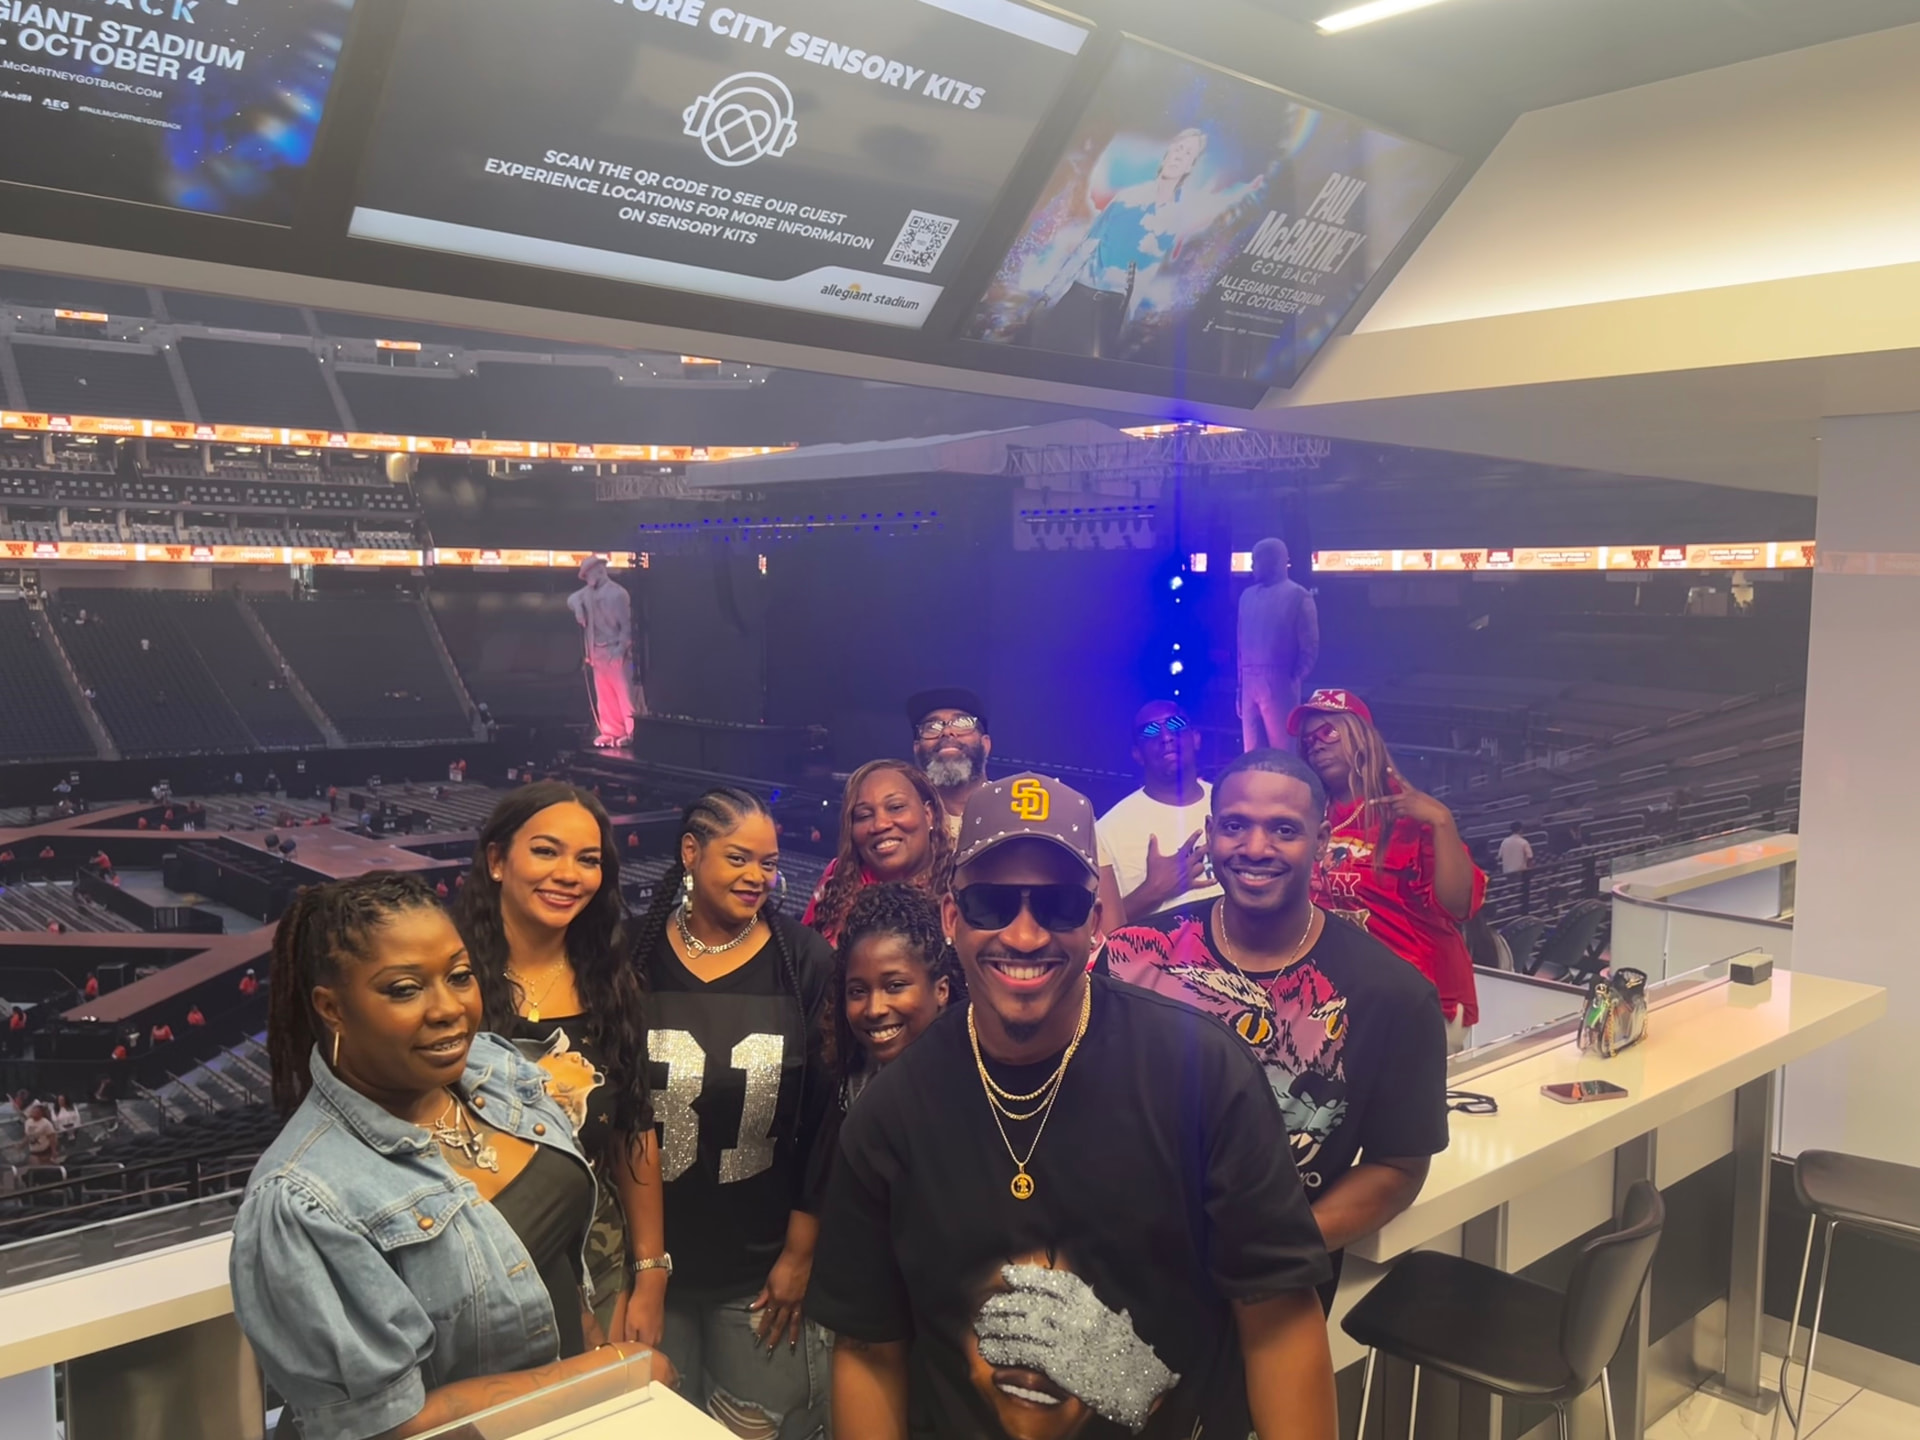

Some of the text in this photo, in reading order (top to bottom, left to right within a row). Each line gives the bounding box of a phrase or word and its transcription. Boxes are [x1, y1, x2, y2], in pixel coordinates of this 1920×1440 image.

[18, 27, 206, 85] OCTOBER 4
[98, 20, 245, 71] STADIUM
[709, 7, 786, 49] CITY
[785, 31, 925, 91] SENSORY
[922, 73, 986, 110] KITS
[0, 60, 163, 99] McCARTNEYGOTBACK.COM
[42, 98, 70, 109] AEG
[484, 157, 875, 250] EXPERIENCE LOCATIONS FOR MORE INFORMATION
[543, 149, 847, 226] SCAN THE QR CODE TO SEE OUR GUEST
[1305, 172, 1367, 225] PAUL
[618, 206, 758, 244] ON SENSORY KITS
[1243, 210, 1368, 274] McCARTNEY
[1216, 274, 1326, 307] ALLEGIANT STADIUM
[1251, 260, 1322, 286] GOT BACK
[820, 283, 920, 311] allegiant stadium
[1220, 289, 1246, 305] SAT.
[1246, 294, 1299, 314] OCTOBER
[1010, 778, 1050, 821] SD
[648, 1029, 784, 1184] 31
